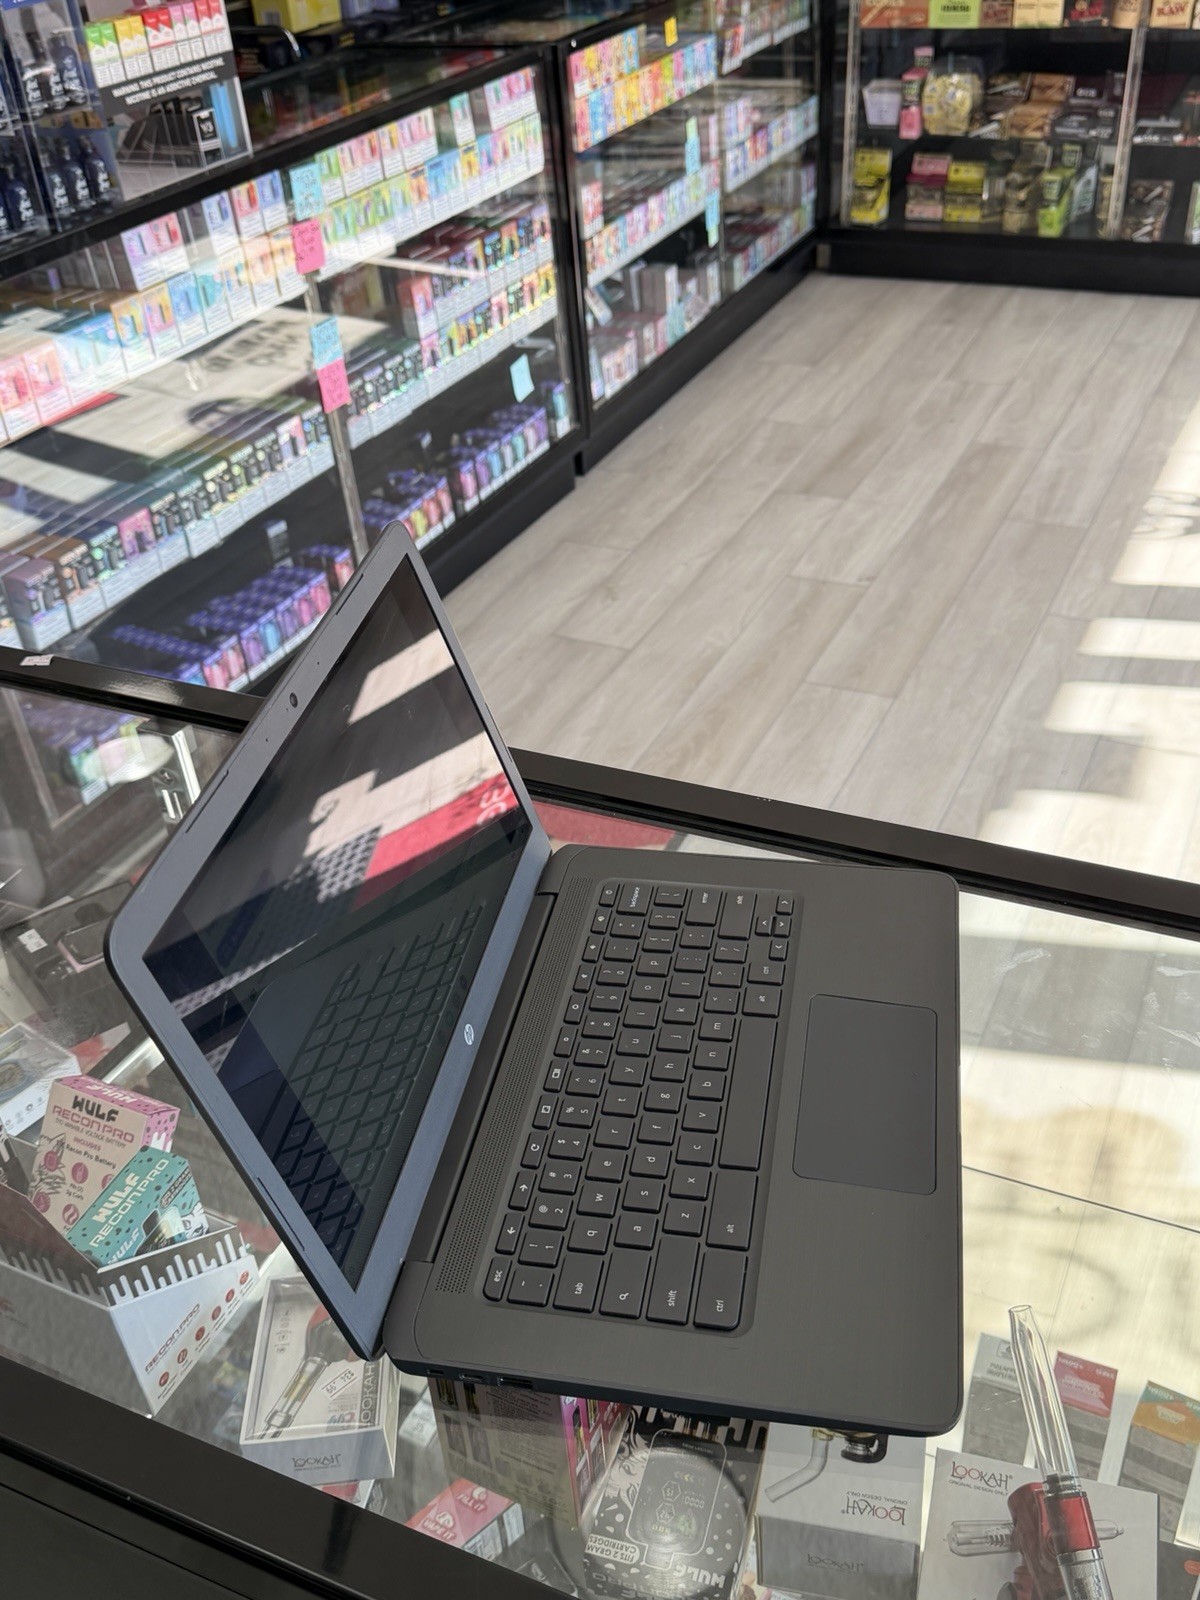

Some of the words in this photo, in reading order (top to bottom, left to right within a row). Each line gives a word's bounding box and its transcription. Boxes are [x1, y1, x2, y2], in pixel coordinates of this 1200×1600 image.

[630, 887, 640, 907] backspace
[72, 1095, 119, 1122] WULF
[94, 1154, 117, 1169] Battery
[90, 1172, 142, 1223] WULF
[494, 1270, 502, 1282] esc
[575, 1283, 583, 1294] tab
[668, 1290, 677, 1306] shift
[861, 1492, 882, 1502] DESIGN
[974, 1484, 993, 1495] DESIGN
[586, 1544, 612, 1558] GRAM
[588, 1535, 637, 1553] CARTRIDGES
[618, 1553, 635, 1563] FITS
[673, 1565, 726, 1589] WULF
